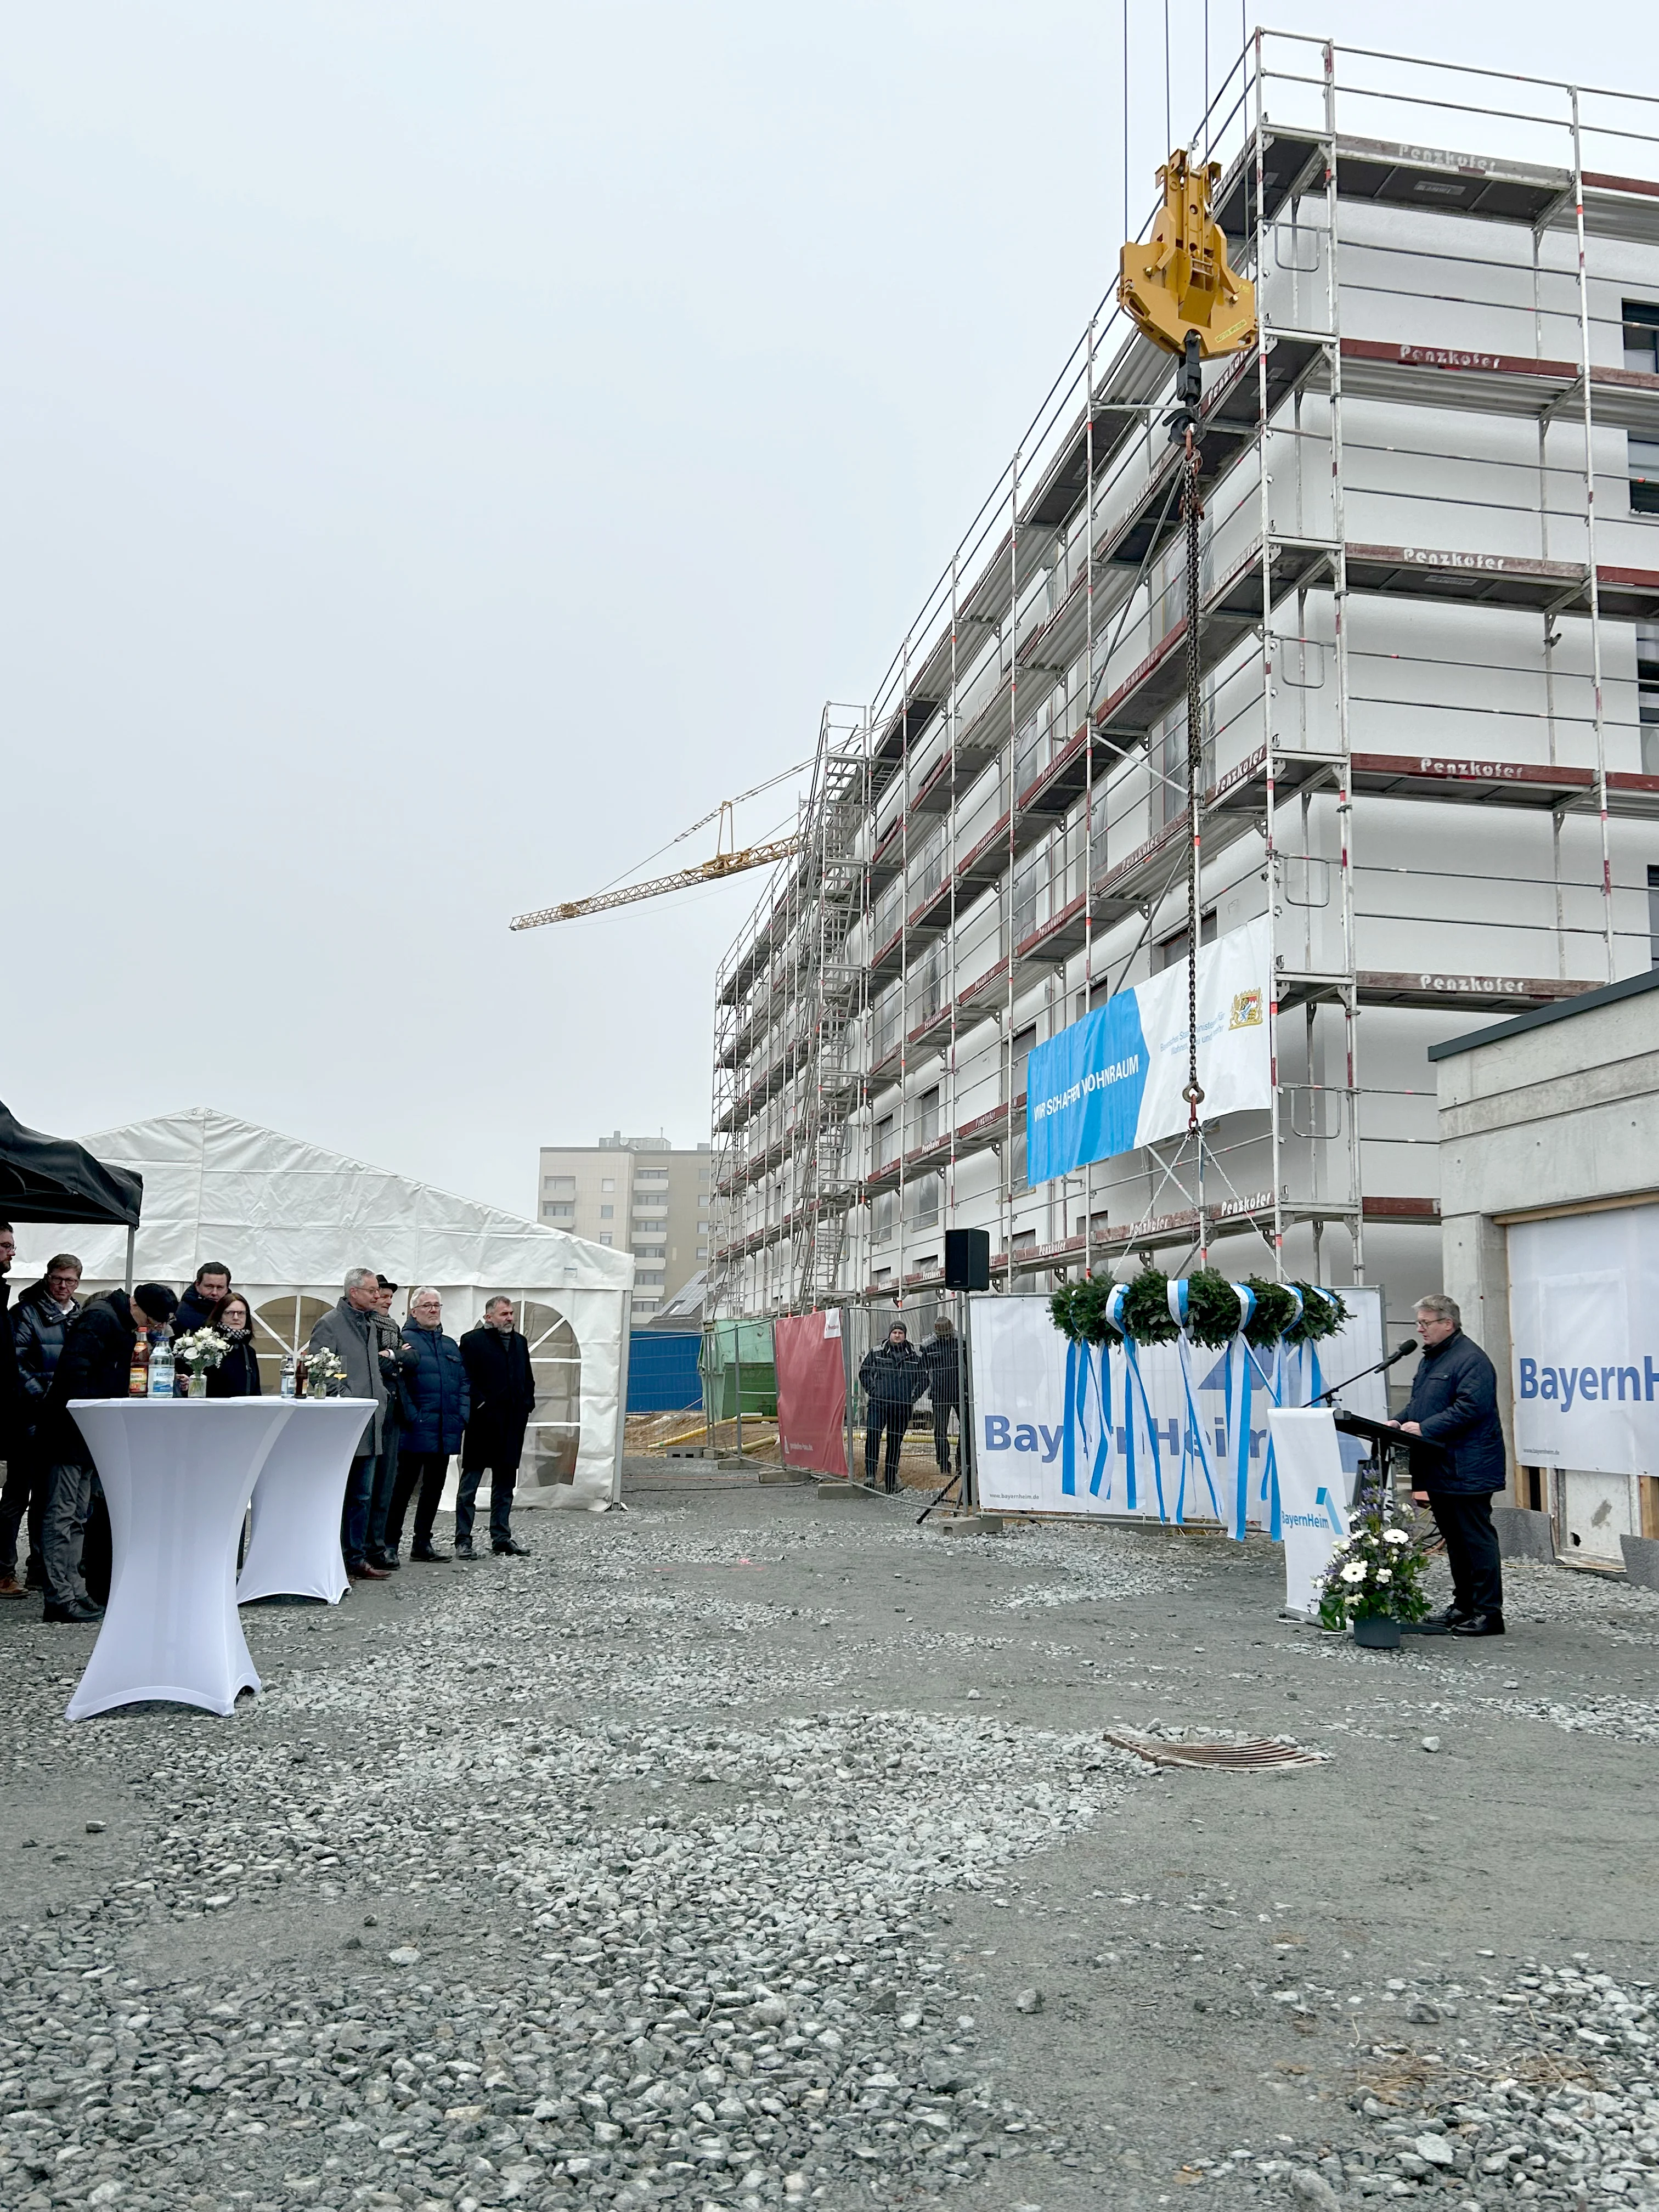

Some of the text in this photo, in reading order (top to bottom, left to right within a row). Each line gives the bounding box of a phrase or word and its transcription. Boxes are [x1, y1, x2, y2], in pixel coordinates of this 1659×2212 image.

[1399, 144, 1496, 171] Penzkofer
[1401, 344, 1500, 369] Penzkofer
[1403, 548, 1504, 570] Penzkofer
[1215, 748, 1263, 795] Penzkofer
[1420, 757, 1523, 778] Penzkofer
[1420, 974, 1525, 993] Penzkofer
[1034, 1102, 1046, 1122] WIR
[1081, 1054, 1139, 1096] WOHNRAUM
[1221, 1192, 1271, 1217] Penzkofer
